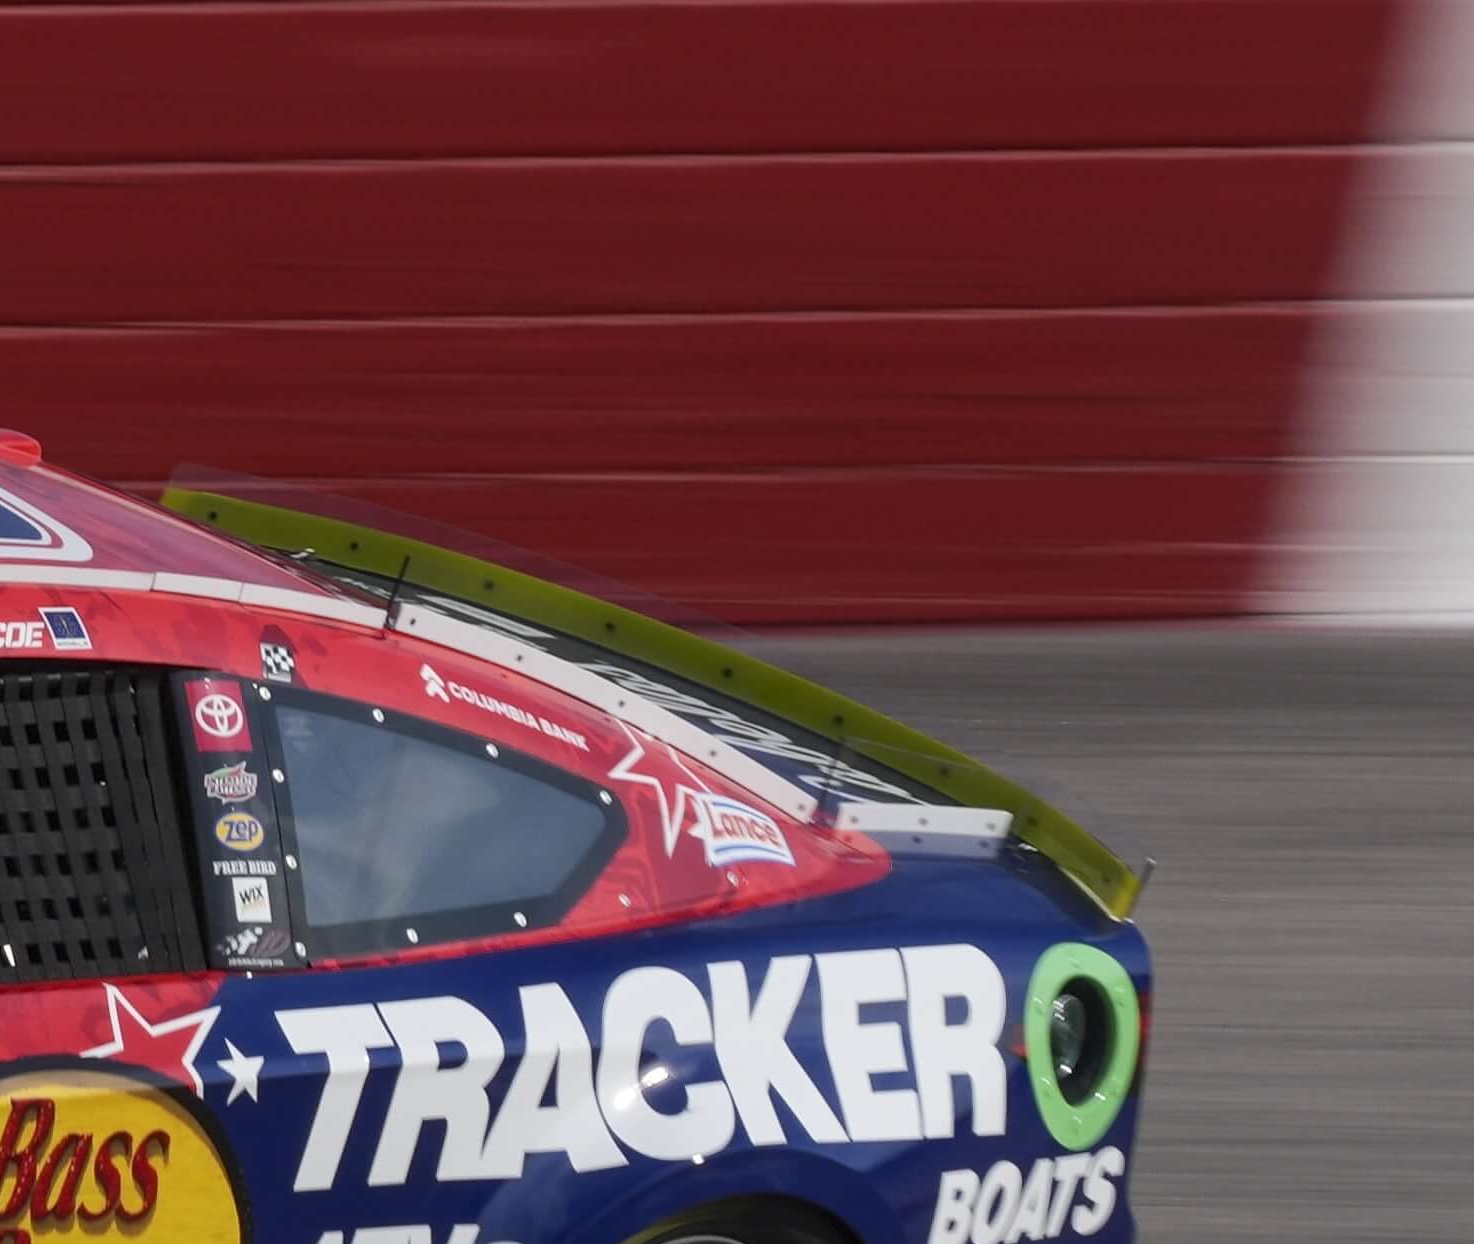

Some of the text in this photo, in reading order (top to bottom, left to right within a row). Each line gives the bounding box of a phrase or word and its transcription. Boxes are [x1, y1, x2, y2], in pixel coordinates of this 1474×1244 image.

[447, 681, 590, 752] COLUMBIA BANK
[703, 800, 782, 848] Lance
[213, 860, 277, 876] FREE BIRD
[238, 885, 264, 906] WIX
[273, 943, 1009, 1193] TRACKER
